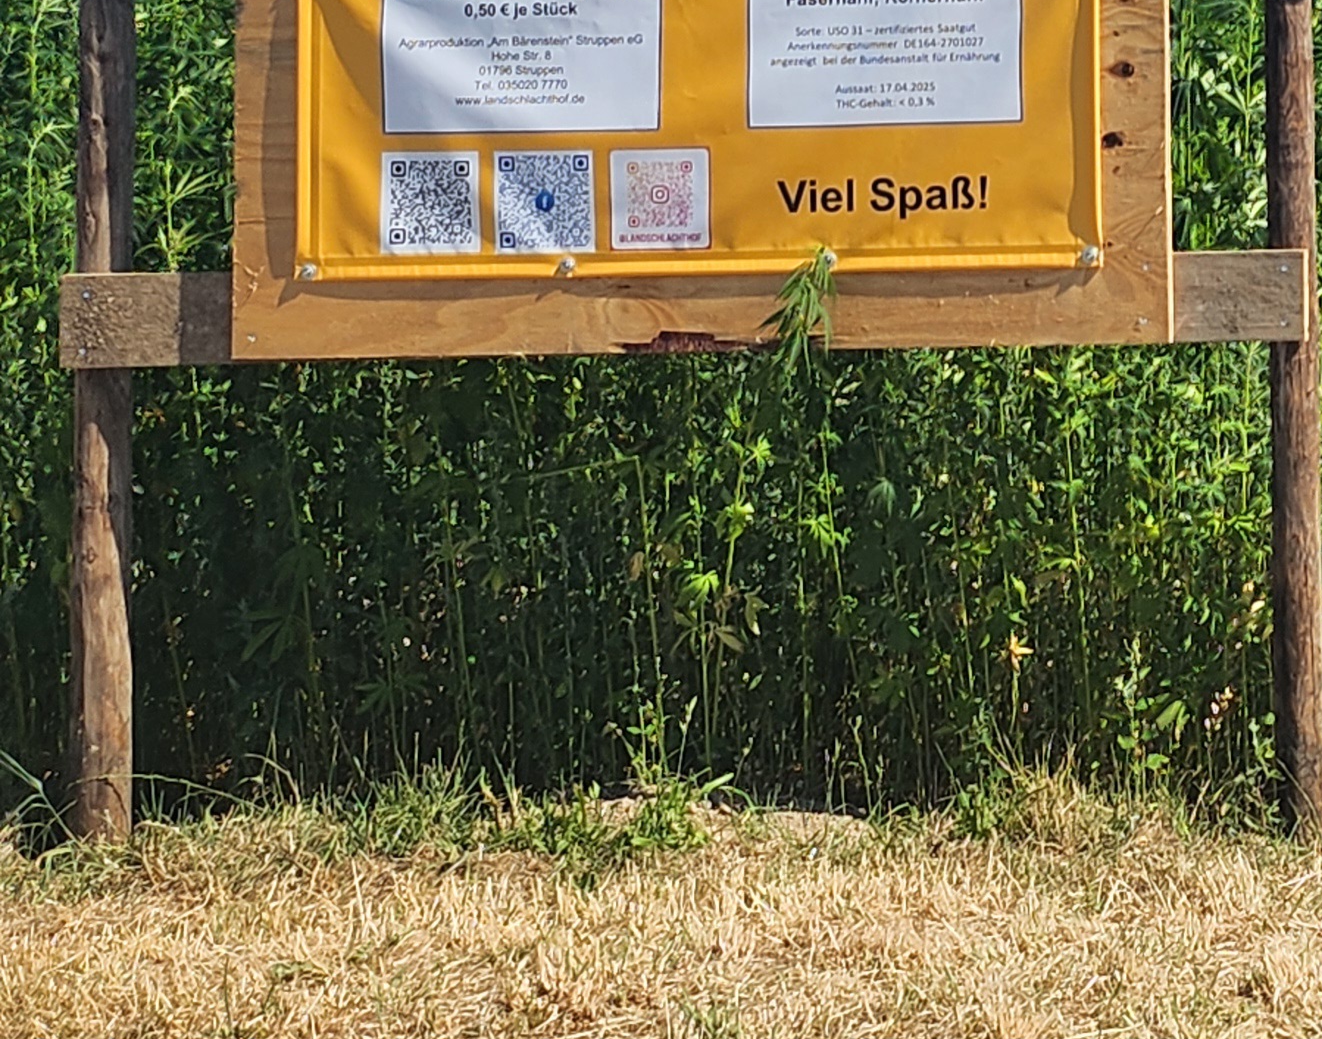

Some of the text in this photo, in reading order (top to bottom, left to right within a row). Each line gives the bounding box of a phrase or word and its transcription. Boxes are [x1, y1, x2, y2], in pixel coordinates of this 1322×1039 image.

[464, 2, 577, 20] 0,50 € je Stück
[827, 26, 849, 35] USO
[851, 25, 863, 35] 31
[875, 24, 933, 35] zertifiziertes
[937, 23, 976, 33] Saatgut
[399, 37, 484, 49] Agrarproduktion
[576, 36, 624, 46] Struppen
[627, 34, 643, 44] eG
[904, 37, 984, 49] DE164-2701027
[491, 51, 551, 61] Hohe Str. 8
[770, 52, 1000, 67] angezeigt bei der Bundesanstalt für Ernährung
[479, 65, 564, 77] 01796 Struppen
[475, 79, 567, 90] Tel. 035020 7770
[835, 82, 935, 94] Aussaat: 17.04.2025
[455, 94, 585, 105] www.landschlachthof.de
[837, 98, 896, 109] THC-Gehalt:
[908, 98, 923, 107] 0,3
[926, 97, 935, 106] %
[777, 176, 987, 219] Viel Spaß!
